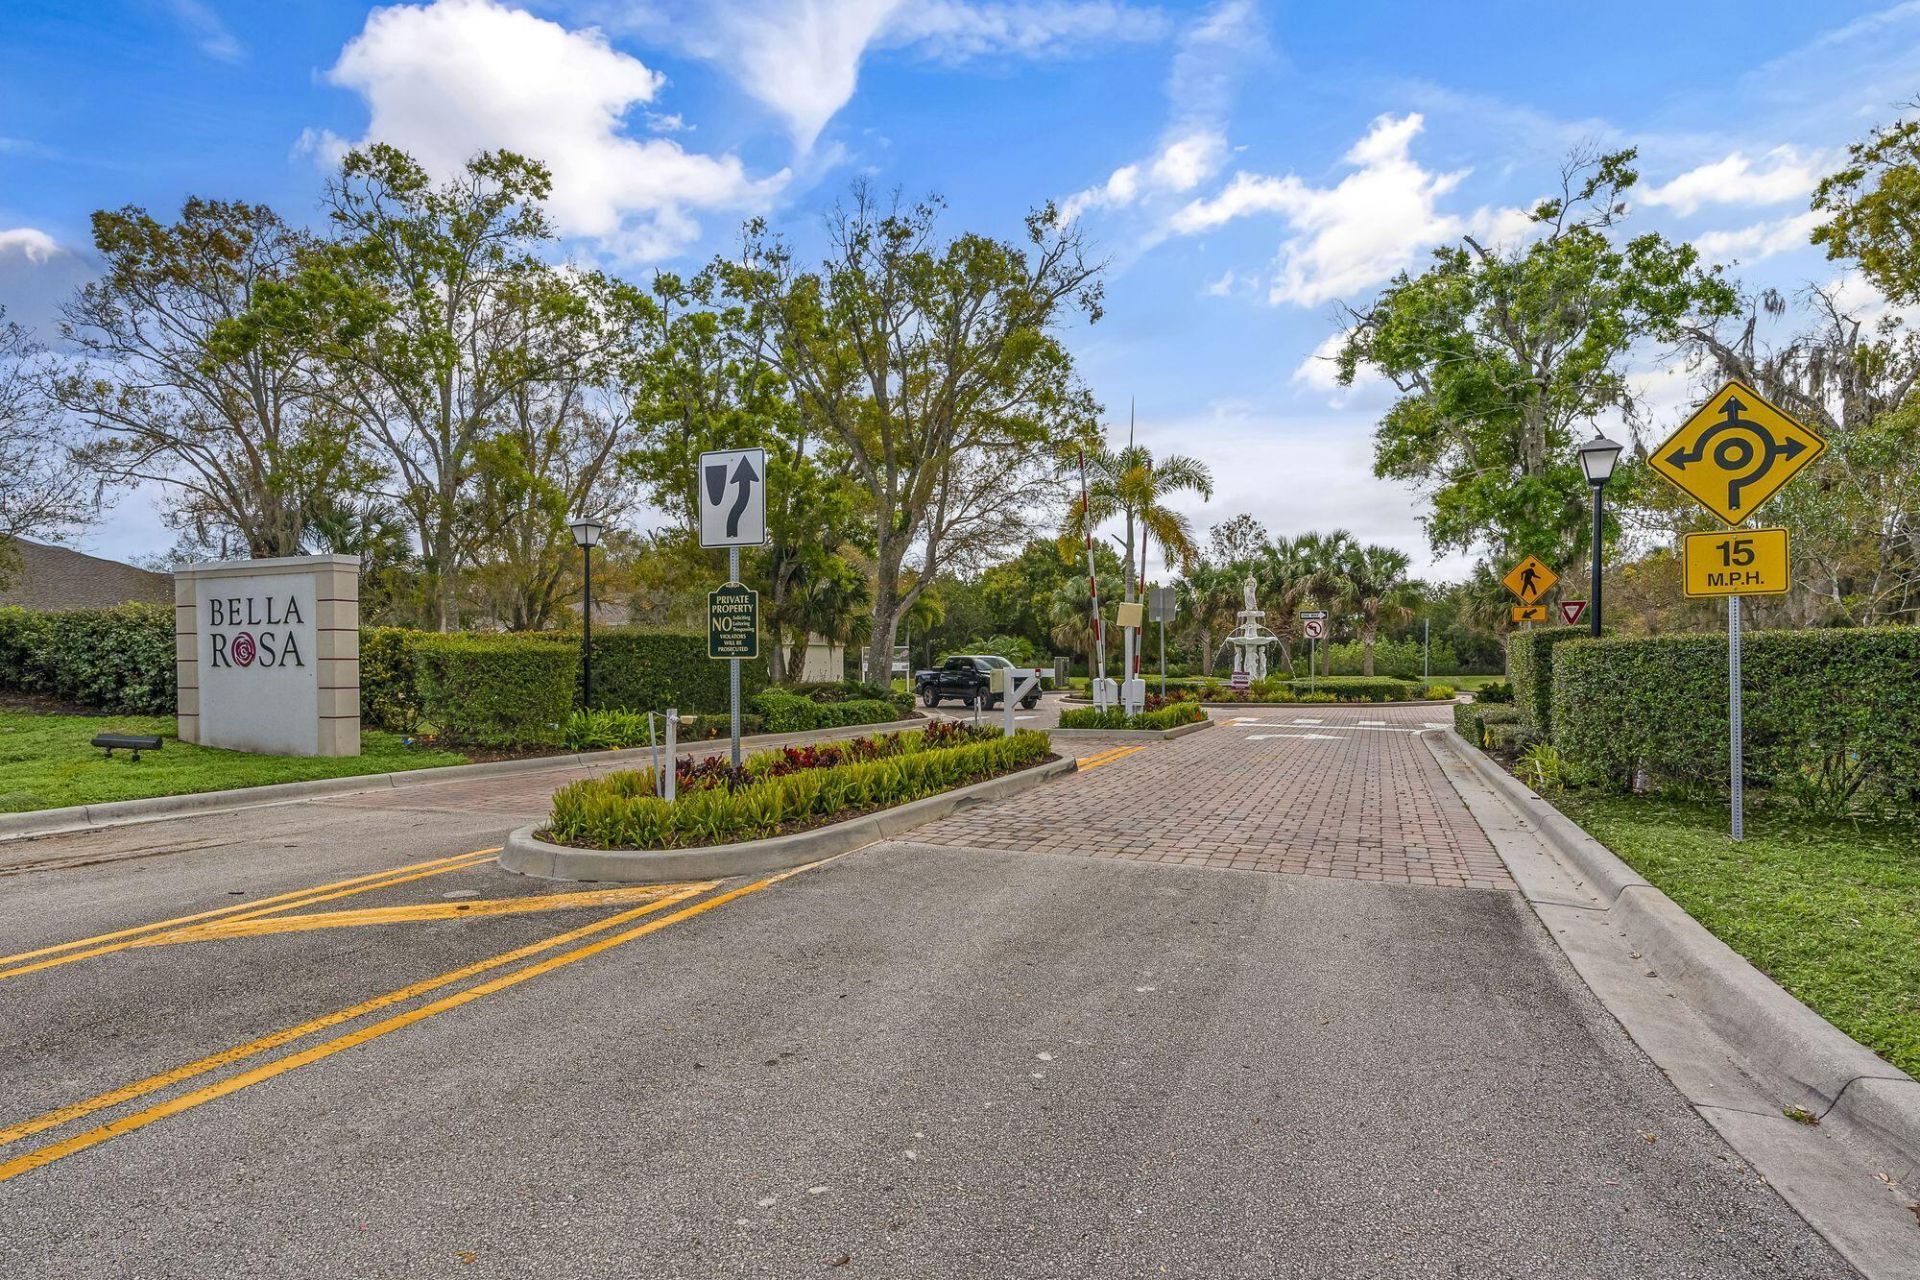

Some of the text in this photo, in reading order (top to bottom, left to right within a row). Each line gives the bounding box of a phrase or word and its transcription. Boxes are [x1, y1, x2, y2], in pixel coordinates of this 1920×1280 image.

[1716, 539, 1755, 567] 15
[1707, 571, 1764, 586] M.P.H.
[716, 595, 750, 604] PRIVATE
[209, 595, 304, 626] BELLA
[711, 604, 754, 613] PROPERTY
[712, 616, 732, 632] NO
[210, 631, 305, 668] ROSA
